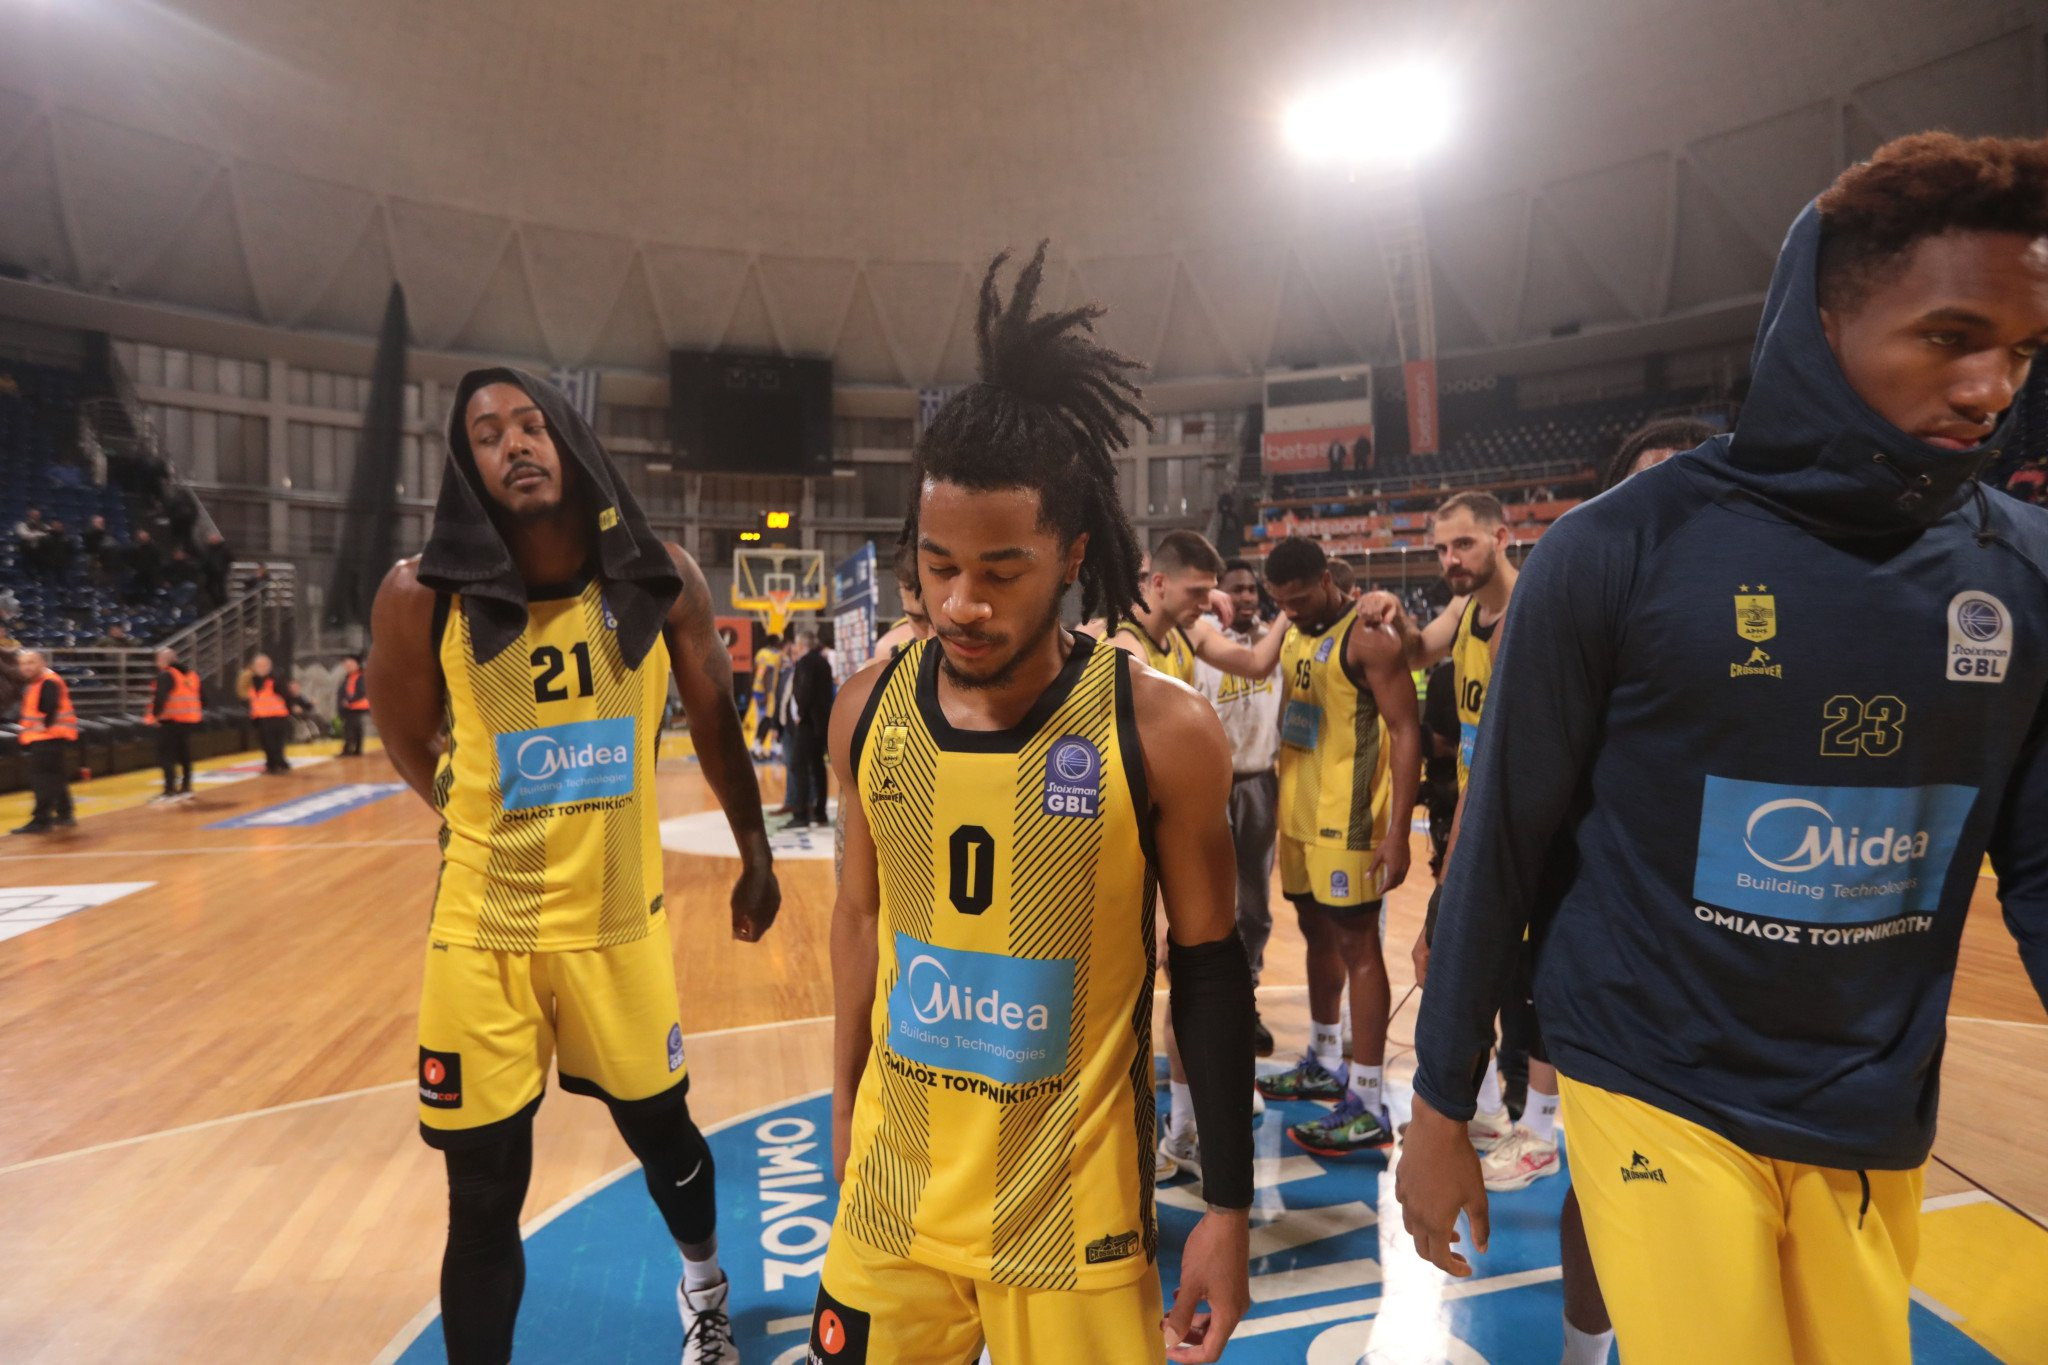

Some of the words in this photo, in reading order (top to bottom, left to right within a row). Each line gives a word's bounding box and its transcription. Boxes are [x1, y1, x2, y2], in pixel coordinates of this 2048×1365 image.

[530, 641, 594, 704] 21
[1730, 662, 1782, 679] CROSSOVER
[1954, 657, 2001, 678] GBL
[1820, 695, 1906, 756] 23
[537, 742, 628, 776] Midea
[1047, 782, 1097, 796] Stoiximan
[1047, 794, 1094, 815] GBL
[502, 807, 555, 823] ΟΜΙΛΟΣ
[949, 825, 995, 915] 0
[1736, 872, 1825, 899] Building
[1694, 905, 1800, 943] ΟΜΙΛΟΣ
[921, 981, 1049, 1031] Midea
[900, 1020, 950, 1048] Building
[955, 1036, 1046, 1063] Technologies
[941, 1074, 1062, 1105] ΤΟΥΡΝΙΚΙΩΤΗ
[1620, 1166, 1667, 1184] CROSSOVER
[755, 1117, 832, 1292] ΟΜΙΛΟΣ
